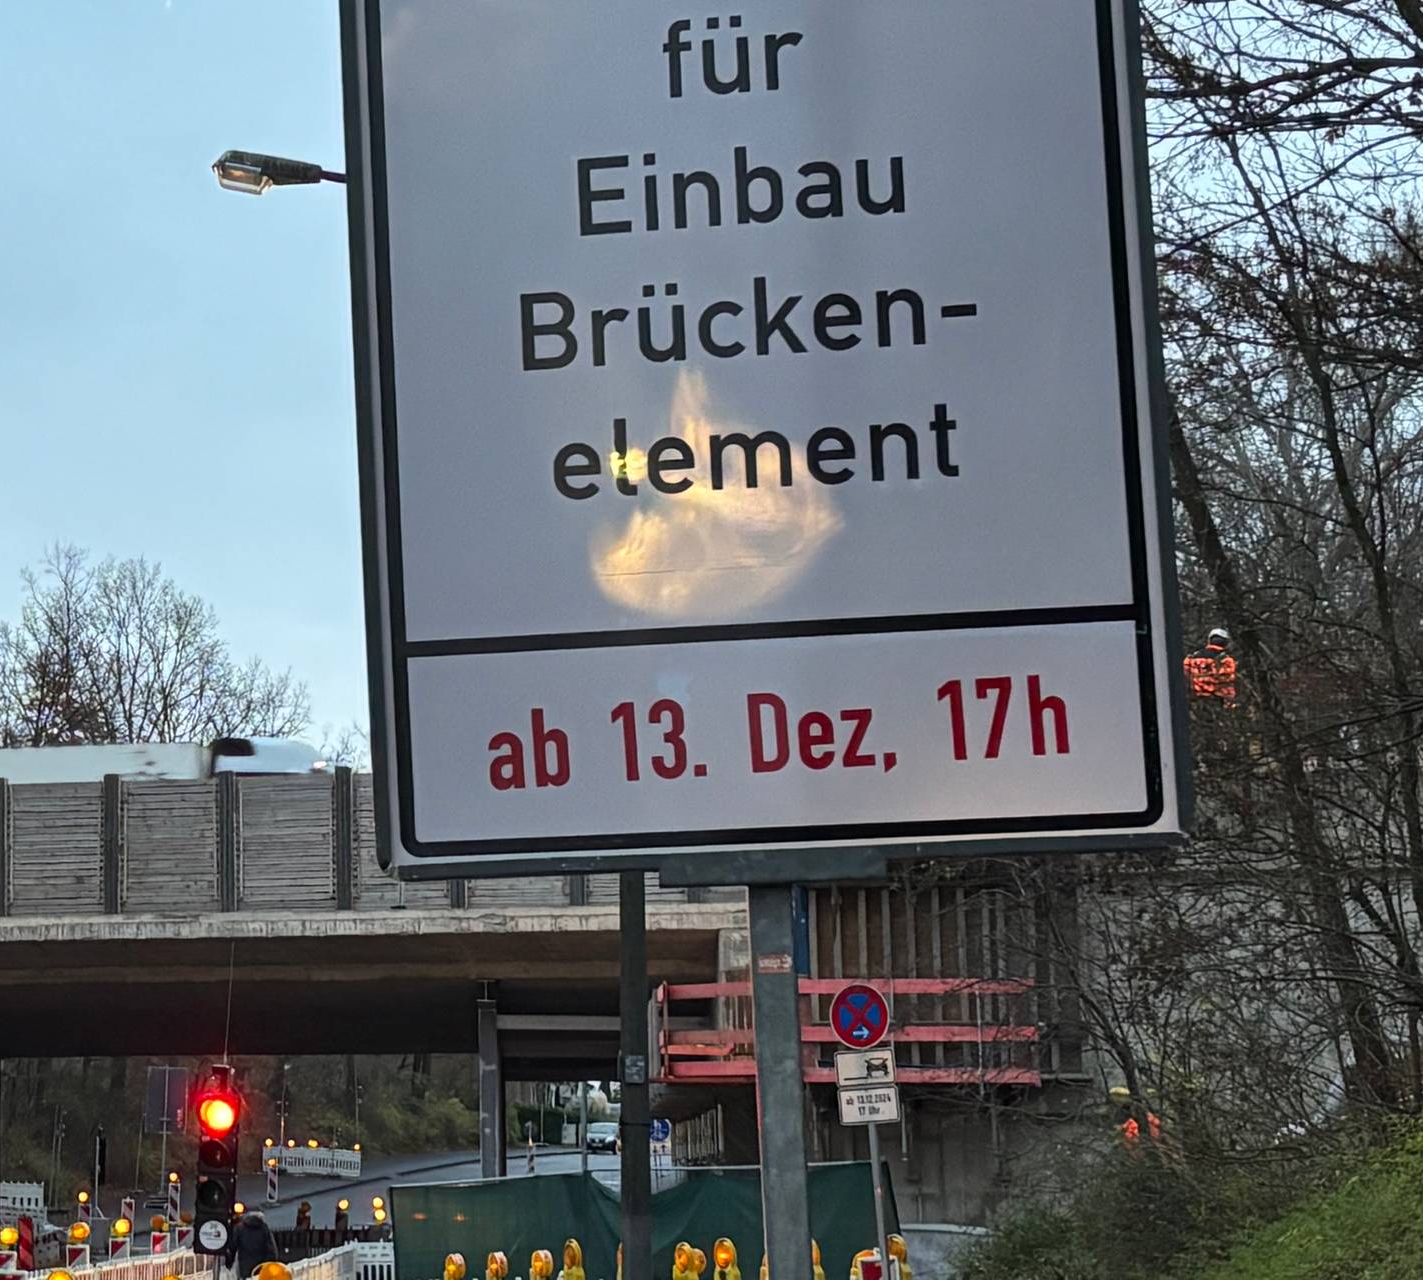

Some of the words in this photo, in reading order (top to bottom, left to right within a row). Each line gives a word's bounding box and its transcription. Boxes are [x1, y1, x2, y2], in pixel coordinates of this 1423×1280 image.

[663, 15, 804, 99] für
[577, 145, 906, 237] Einbau
[519, 276, 978, 372] Brücken-
[553, 403, 960, 501] element
[487, 709, 571, 791] ab
[610, 699, 708, 782] 13.
[747, 691, 898, 774] Dez,
[937, 674, 1070, 762] 17h
